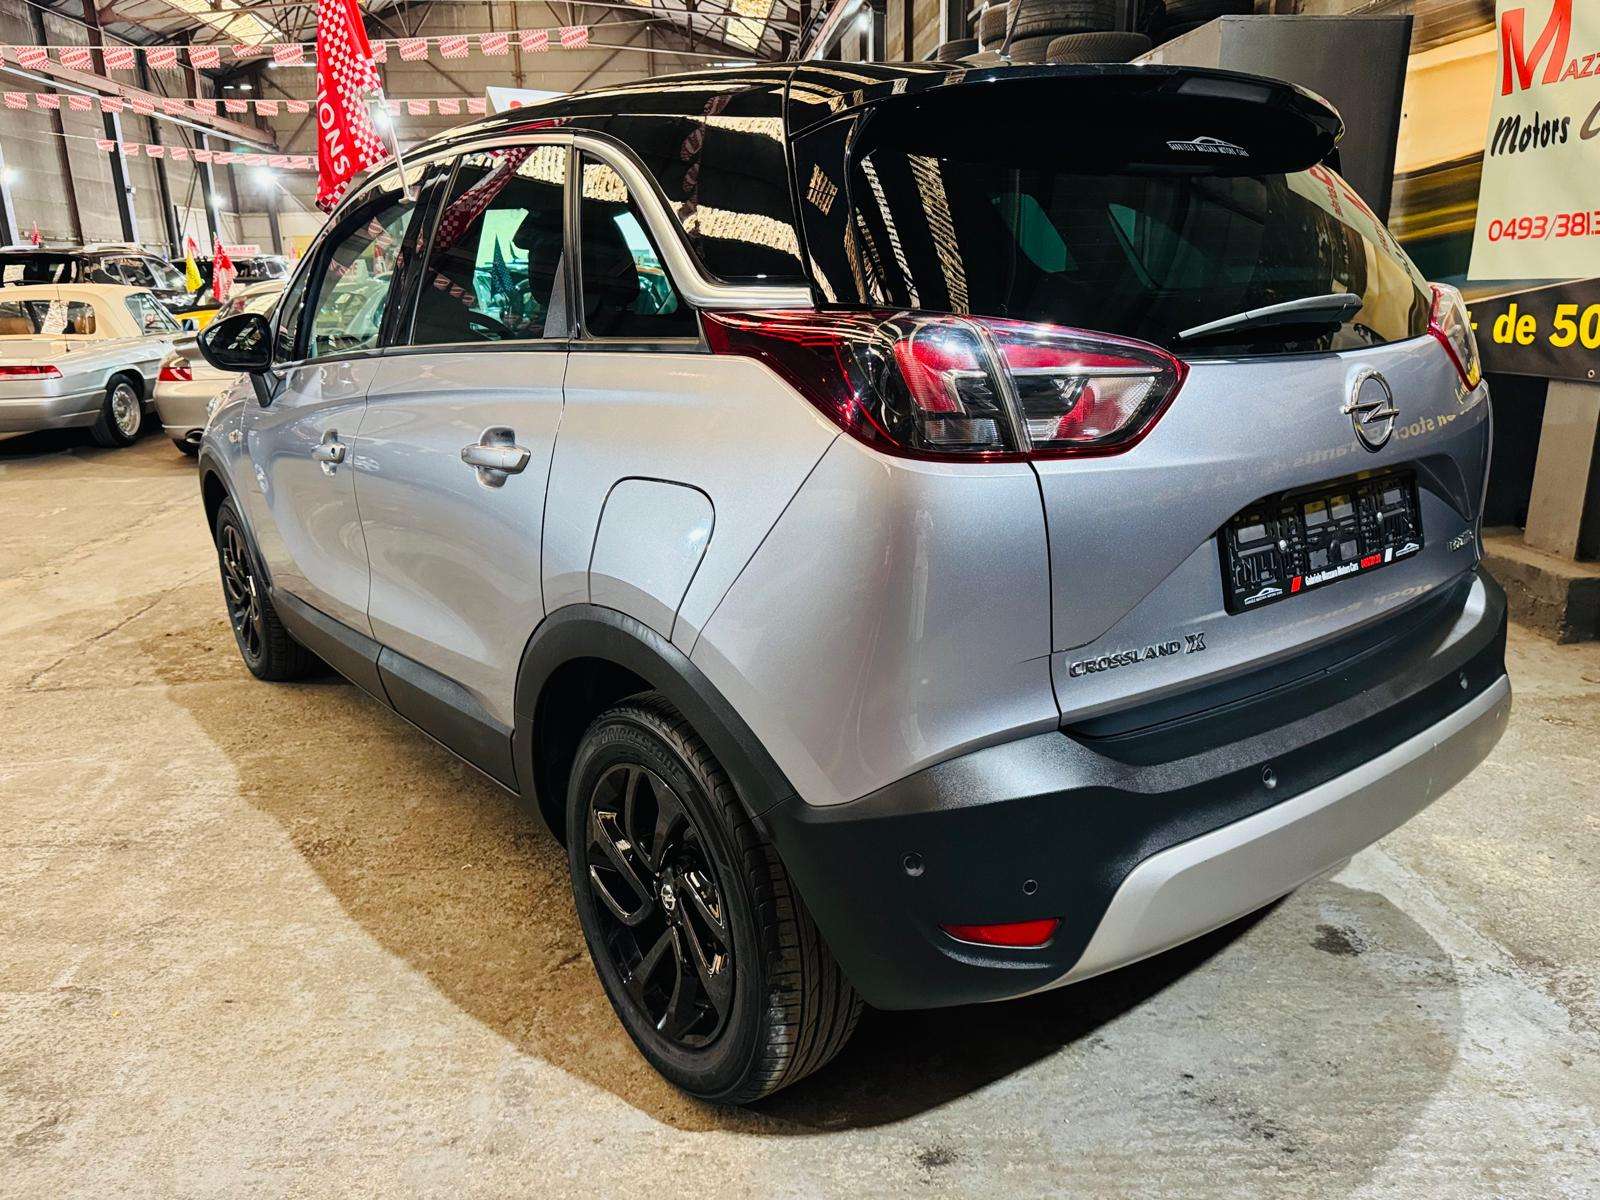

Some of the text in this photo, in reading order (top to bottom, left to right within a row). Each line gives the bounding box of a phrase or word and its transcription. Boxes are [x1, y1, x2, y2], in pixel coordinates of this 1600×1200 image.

[19, 51, 45, 65] OCCASION
[61, 51, 89, 65] OCCASION
[106, 51, 132, 65] OCCASION
[148, 50, 175, 65] OCCASION
[190, 50, 217, 64] OCCASION
[1491, 111, 1570, 157] Motors
[1493, 303, 1537, 345] de
[1549, 304, 1600, 349] 50
[1068, 632, 1207, 678] CROSSLAND X
